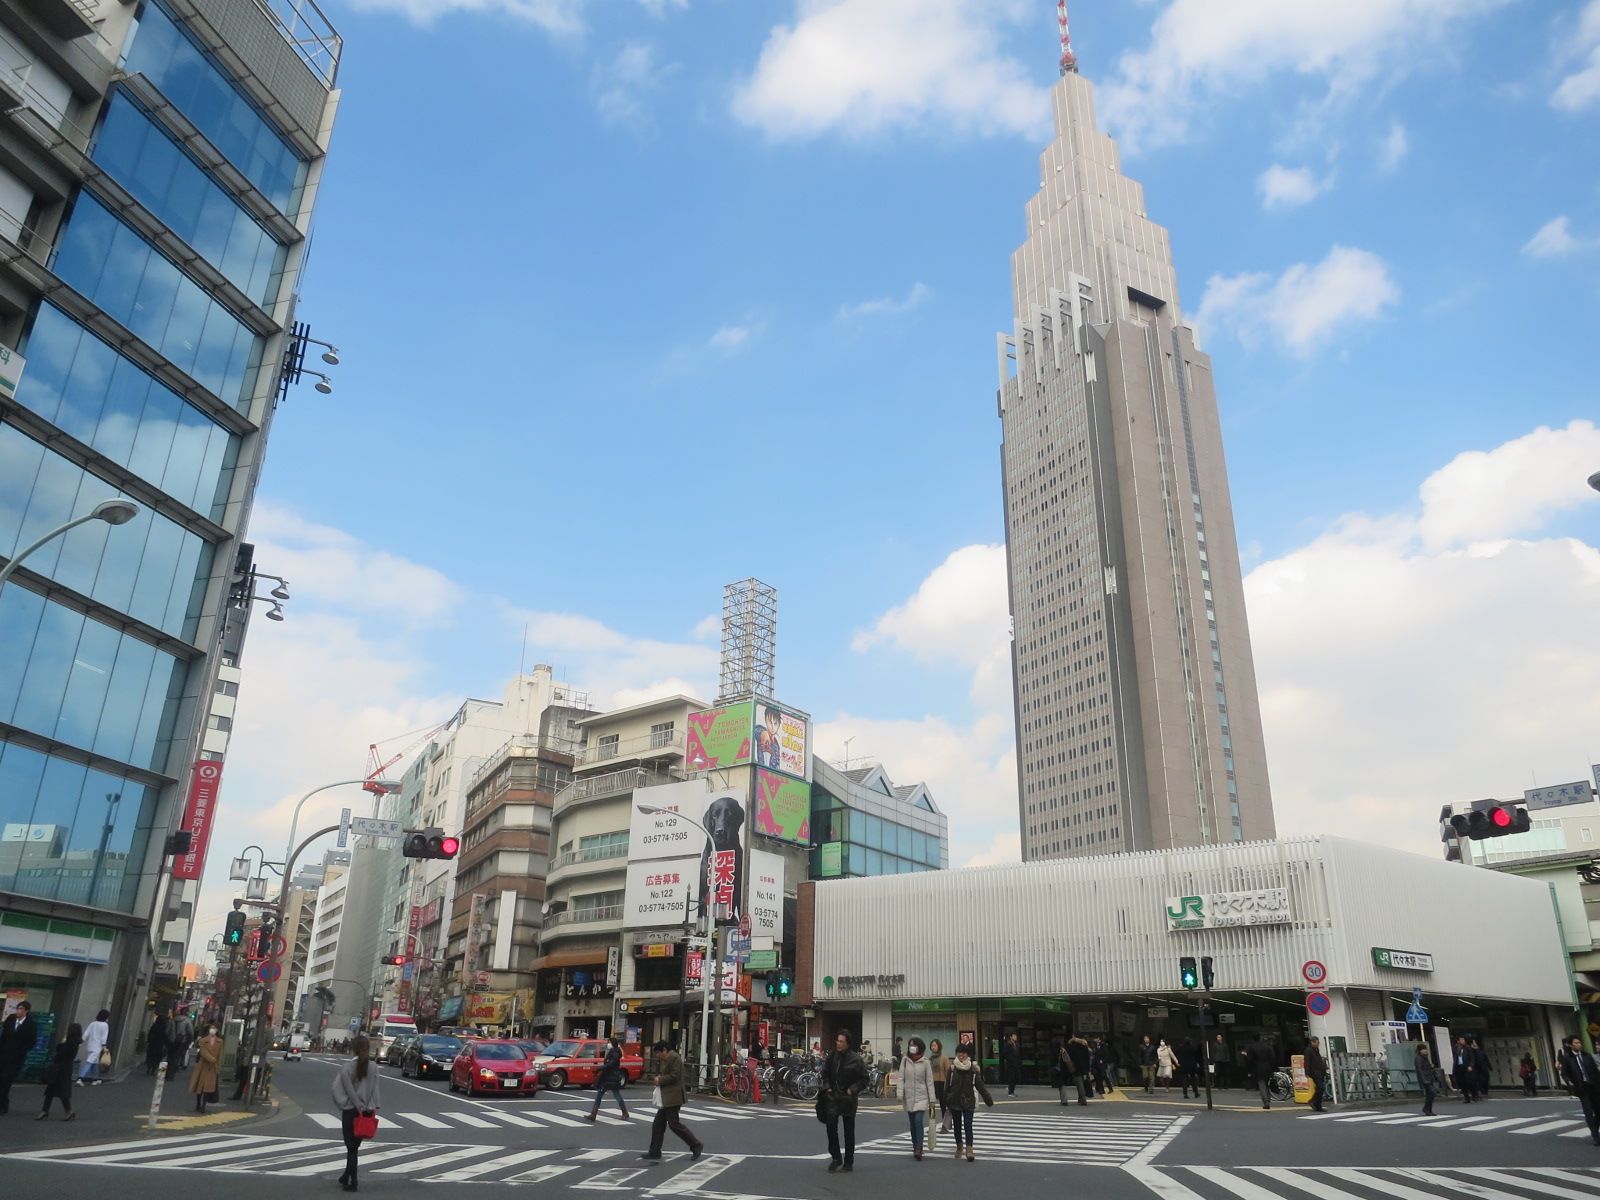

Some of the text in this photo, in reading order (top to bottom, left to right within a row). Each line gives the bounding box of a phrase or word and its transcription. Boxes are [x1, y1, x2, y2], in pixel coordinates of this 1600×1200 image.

[183, 788, 210, 873] 三菱東京UFJ銀行
[643, 831, 688, 845] 03-5774-7505
[645, 873, 681, 887] 広告募集
[650, 888, 673, 899] No.122
[756, 890, 777, 902] No.141
[638, 902, 684, 914] 03-5774-7505
[1167, 895, 1205, 919] JR
[1209, 890, 1289, 917] 代々木駅
[754, 906, 778, 919] 03-5774
[758, 917, 774, 929] 7505
[1209, 912, 1290, 928] Yoyogi Station
[1380, 952, 1390, 962] JR
[1392, 953, 1417, 967] 代々木駅
[157, 961, 173, 970] ビル
[1308, 966, 1321, 977] 30
